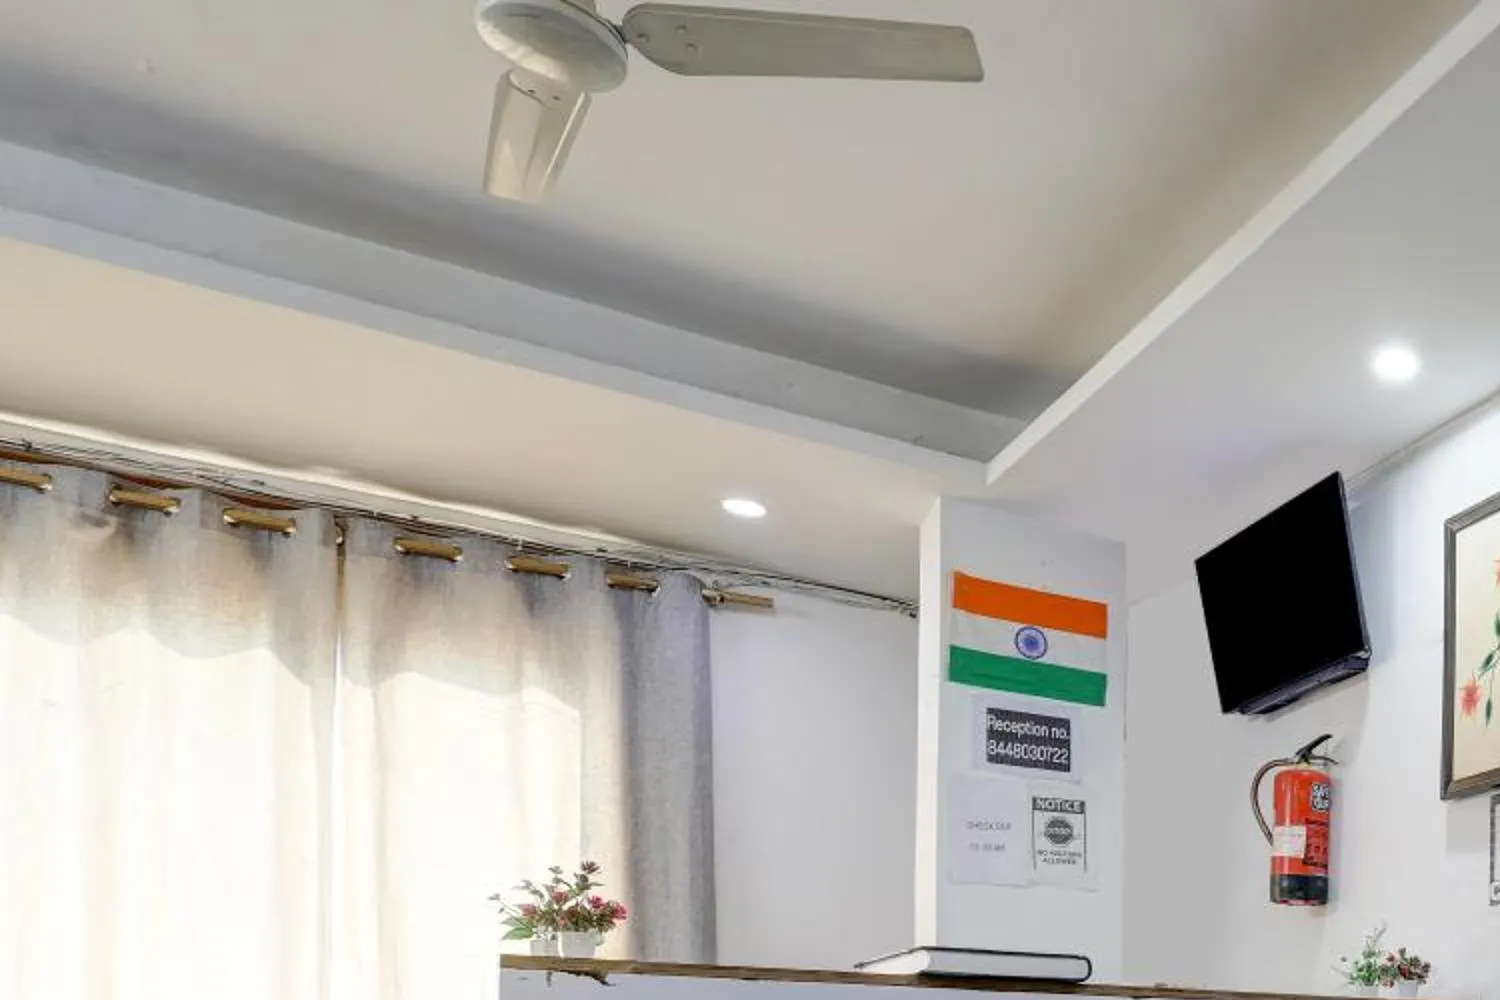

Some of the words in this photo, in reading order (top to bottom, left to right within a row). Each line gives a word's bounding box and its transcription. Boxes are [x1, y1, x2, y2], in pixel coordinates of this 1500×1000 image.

[987, 714, 1049, 739] Reception
[1051, 727, 1070, 739] no.
[1035, 798, 1081, 813] NOTICE
